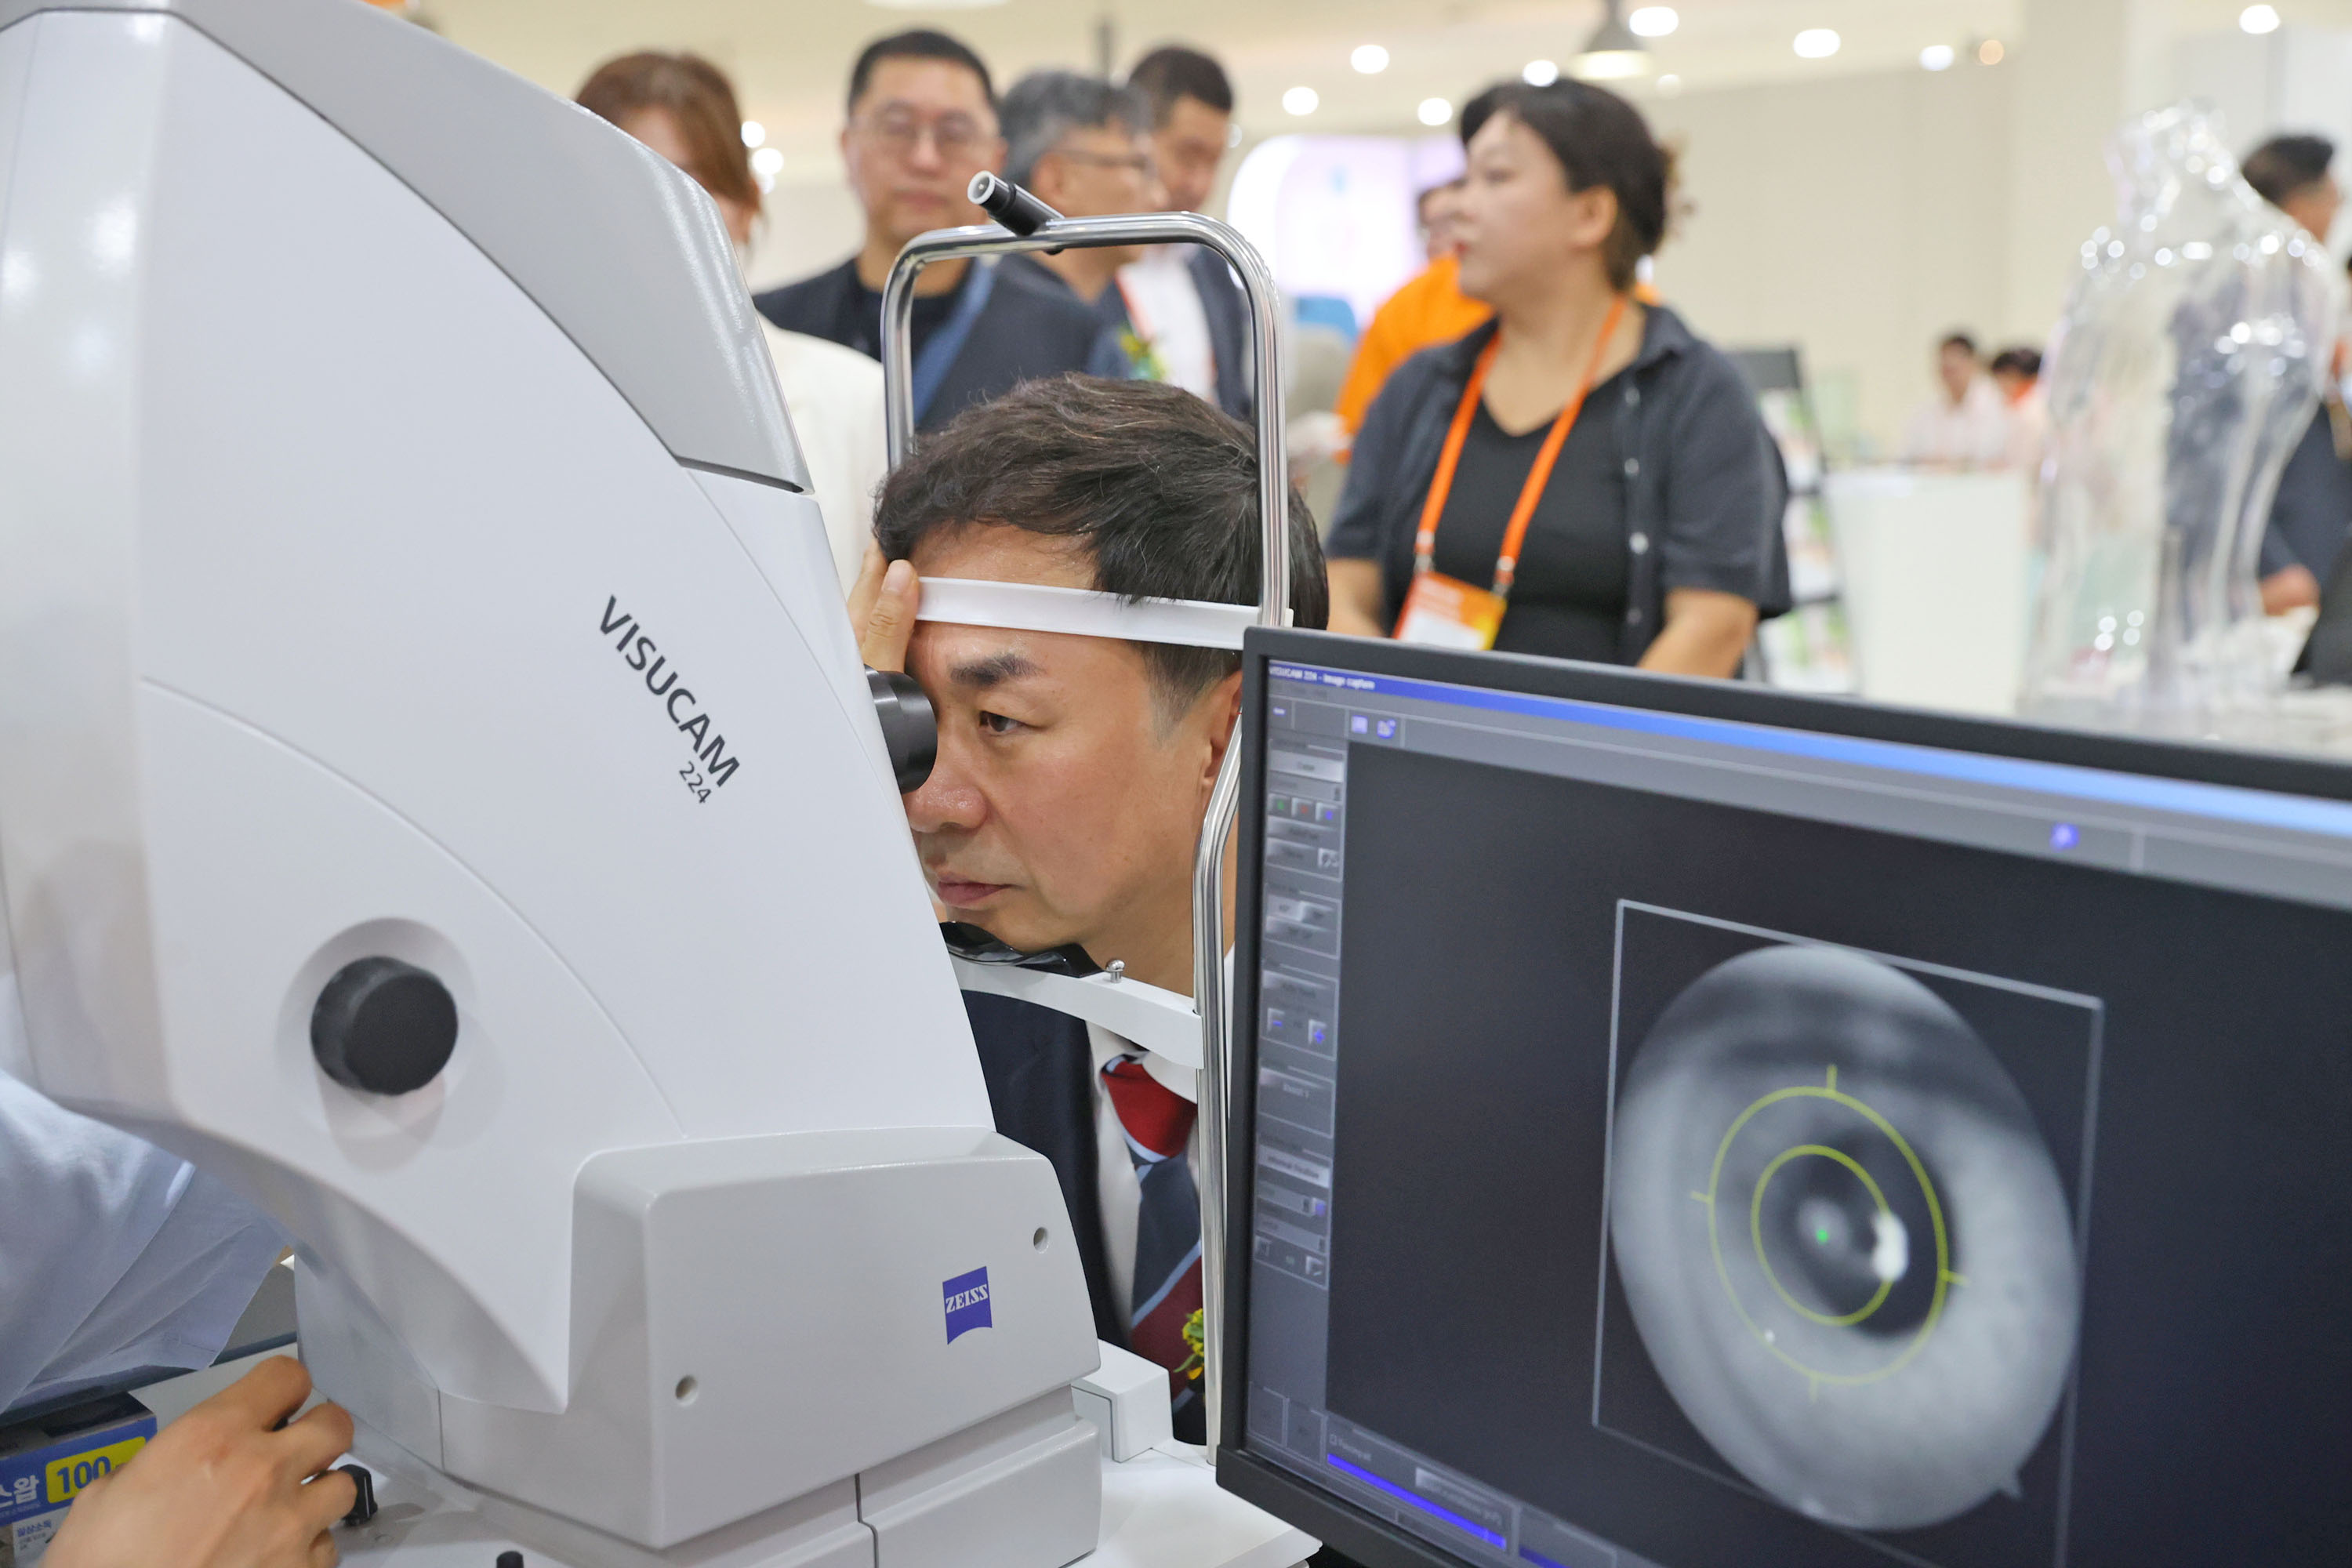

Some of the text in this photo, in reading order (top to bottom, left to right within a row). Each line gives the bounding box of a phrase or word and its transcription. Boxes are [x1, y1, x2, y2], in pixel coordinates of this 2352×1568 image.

[600, 594, 740, 787] VISUCAM
[679, 760, 712, 804] 224
[946, 1283, 989, 1314] ZEISS
[57, 1456, 111, 1494] 100
